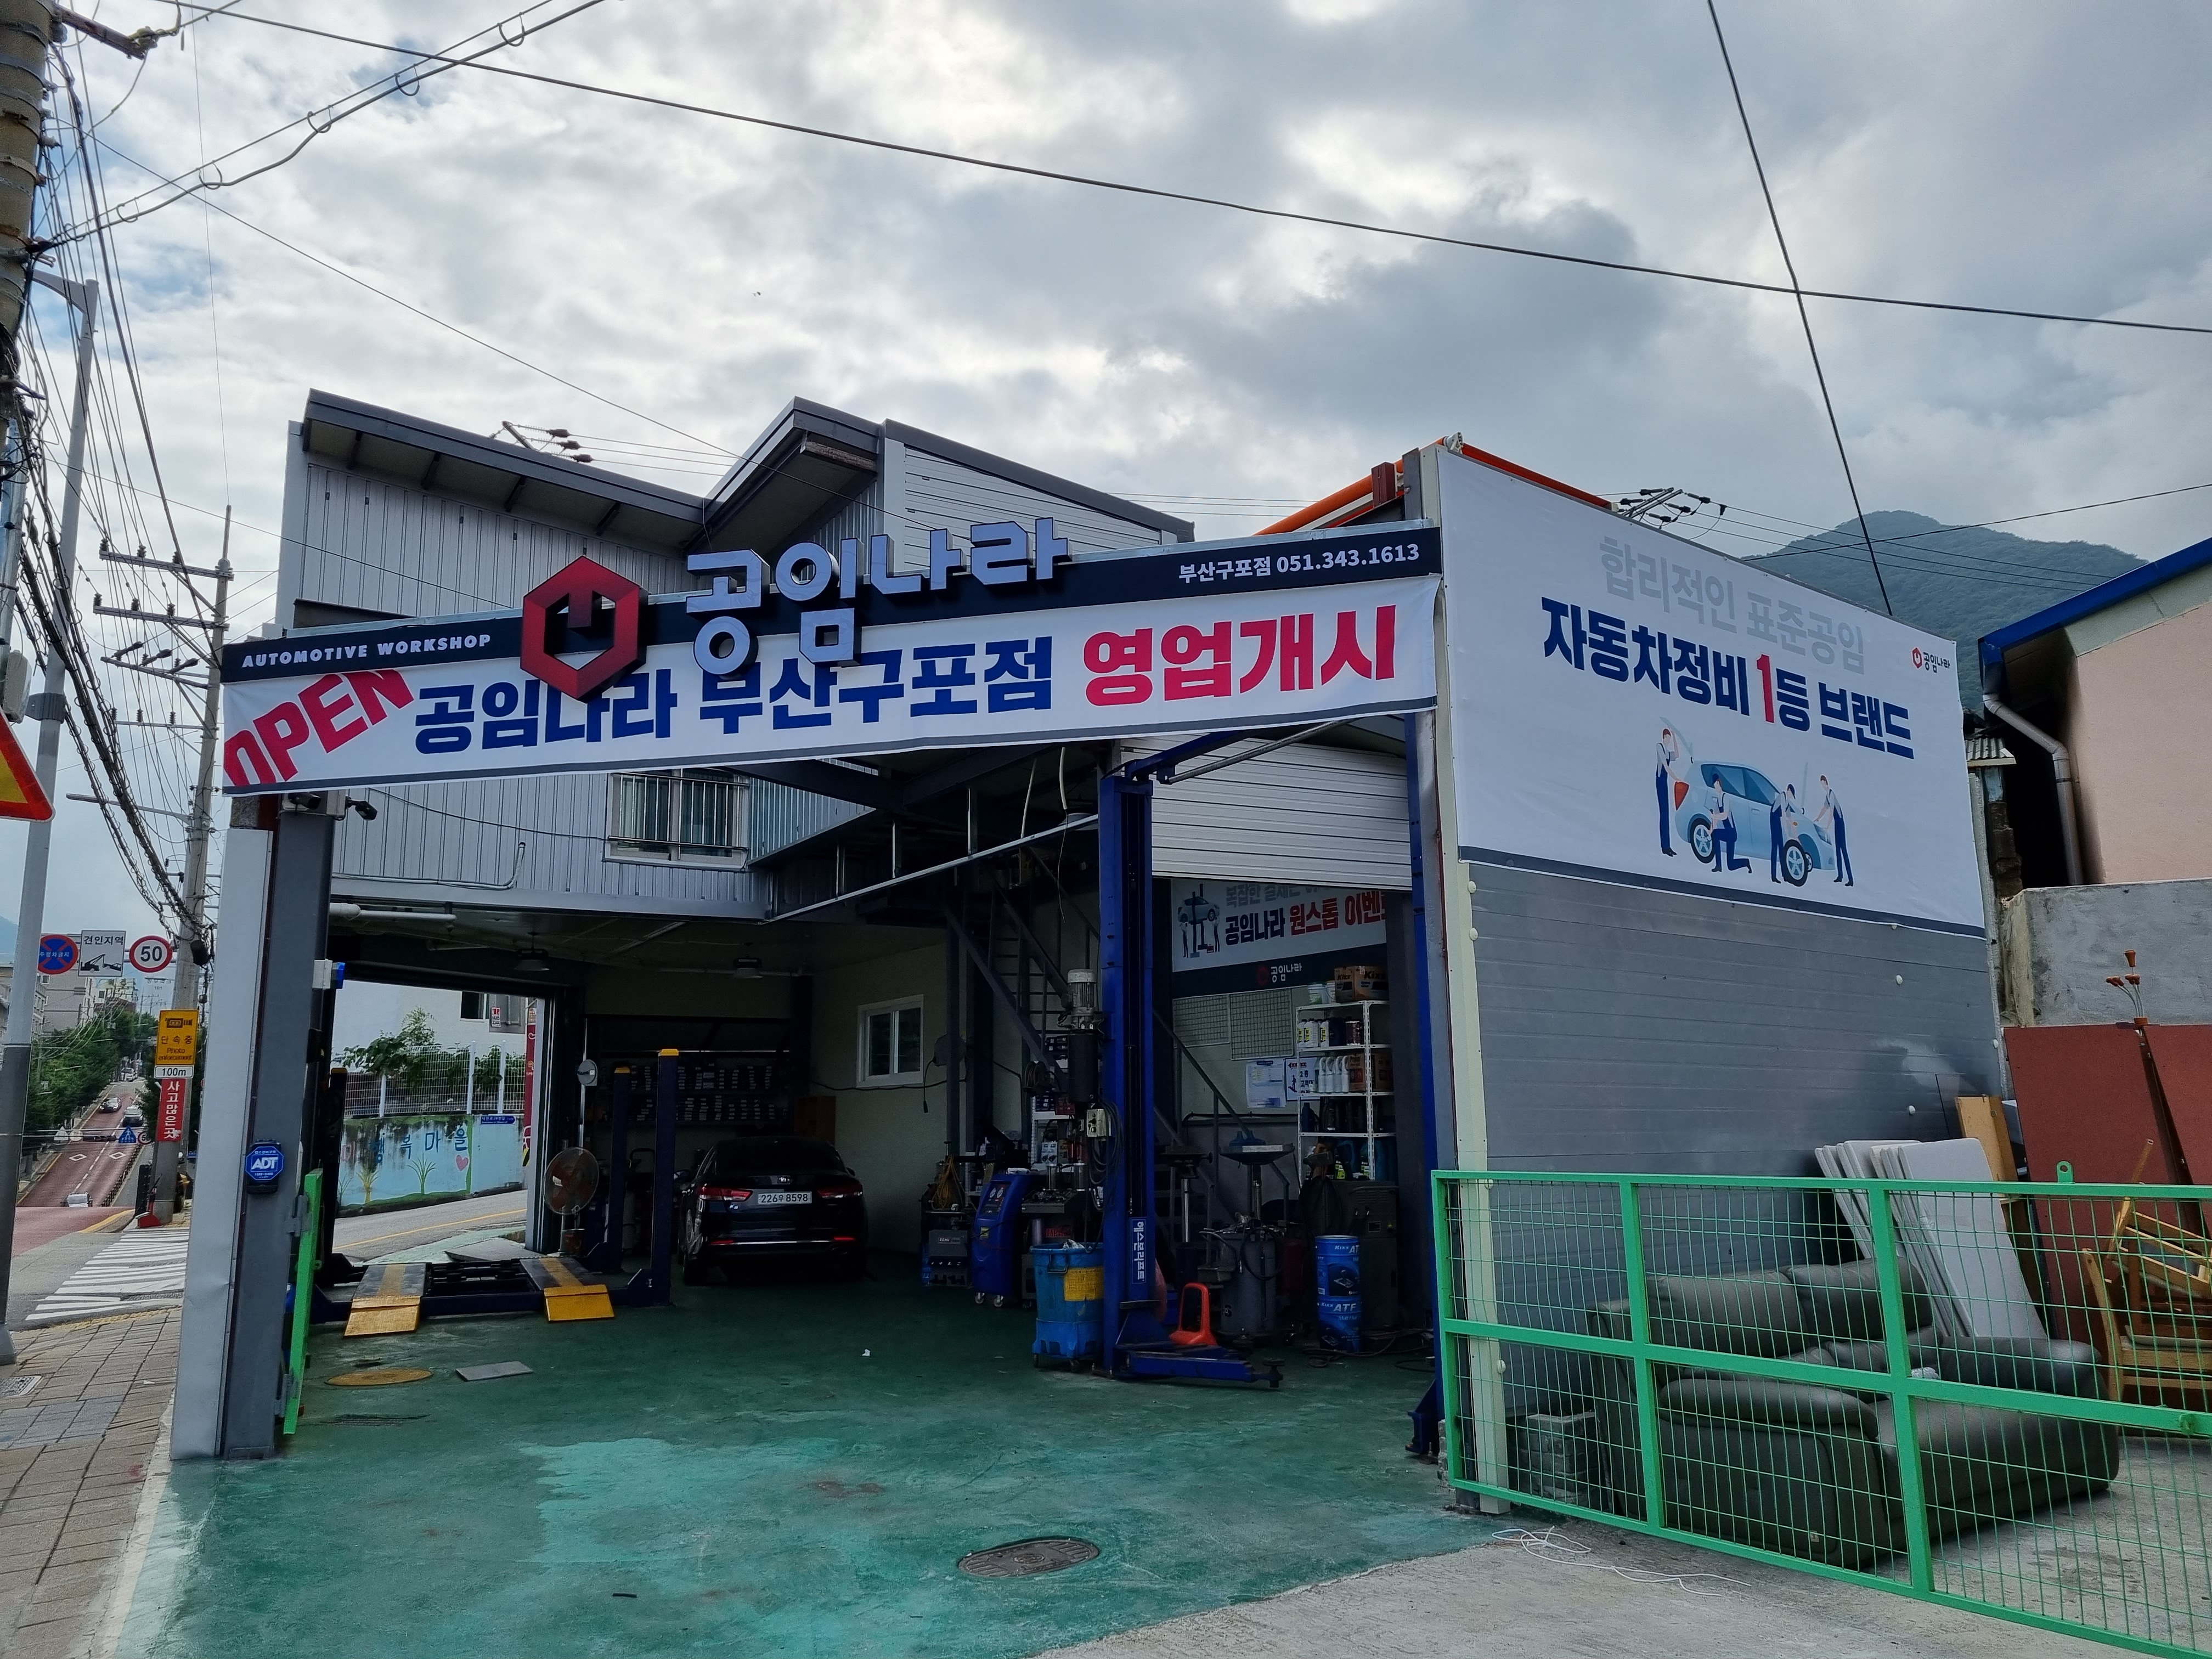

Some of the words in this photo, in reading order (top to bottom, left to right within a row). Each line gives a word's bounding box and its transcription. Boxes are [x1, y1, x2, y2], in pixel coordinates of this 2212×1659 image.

[1178, 556, 1272, 584] 부산구포점
[1276, 543, 1420, 574] 051.343.1613
[686, 516, 1070, 675] 공임나라
[1599, 535, 1737, 634] 합리적인
[1747, 591, 1864, 675] 표준공임
[241, 644, 368, 669] AUTOMOTIVE
[377, 633, 492, 656] WORKSHOP
[1923, 651, 1951, 674] 공임나라
[415, 668, 678, 755] 공임나라
[699, 636, 1052, 735] 부산구포점
[1083, 605, 1396, 707] 영업개시
[1541, 596, 1750, 717] 자동차정비
[1756, 653, 1810, 732] 1등
[1818, 681, 1915, 760] 브랜드
[1225, 907, 1285, 946] 공임나라
[1289, 897, 1339, 936] 원스톱
[1345, 890, 1386, 926] 이벤
[84, 935, 123, 945] 견인지역
[140, 946, 162, 962] 50
[1271, 963, 1302, 983] 공임나라
[162, 1067, 187, 1076] 100m
[251, 1157, 278, 1170] ADT
[786, 1193, 808, 1202] 8598
[1348, 1245, 1360, 1254] AT
[1333, 1303, 1357, 1312] ATF
